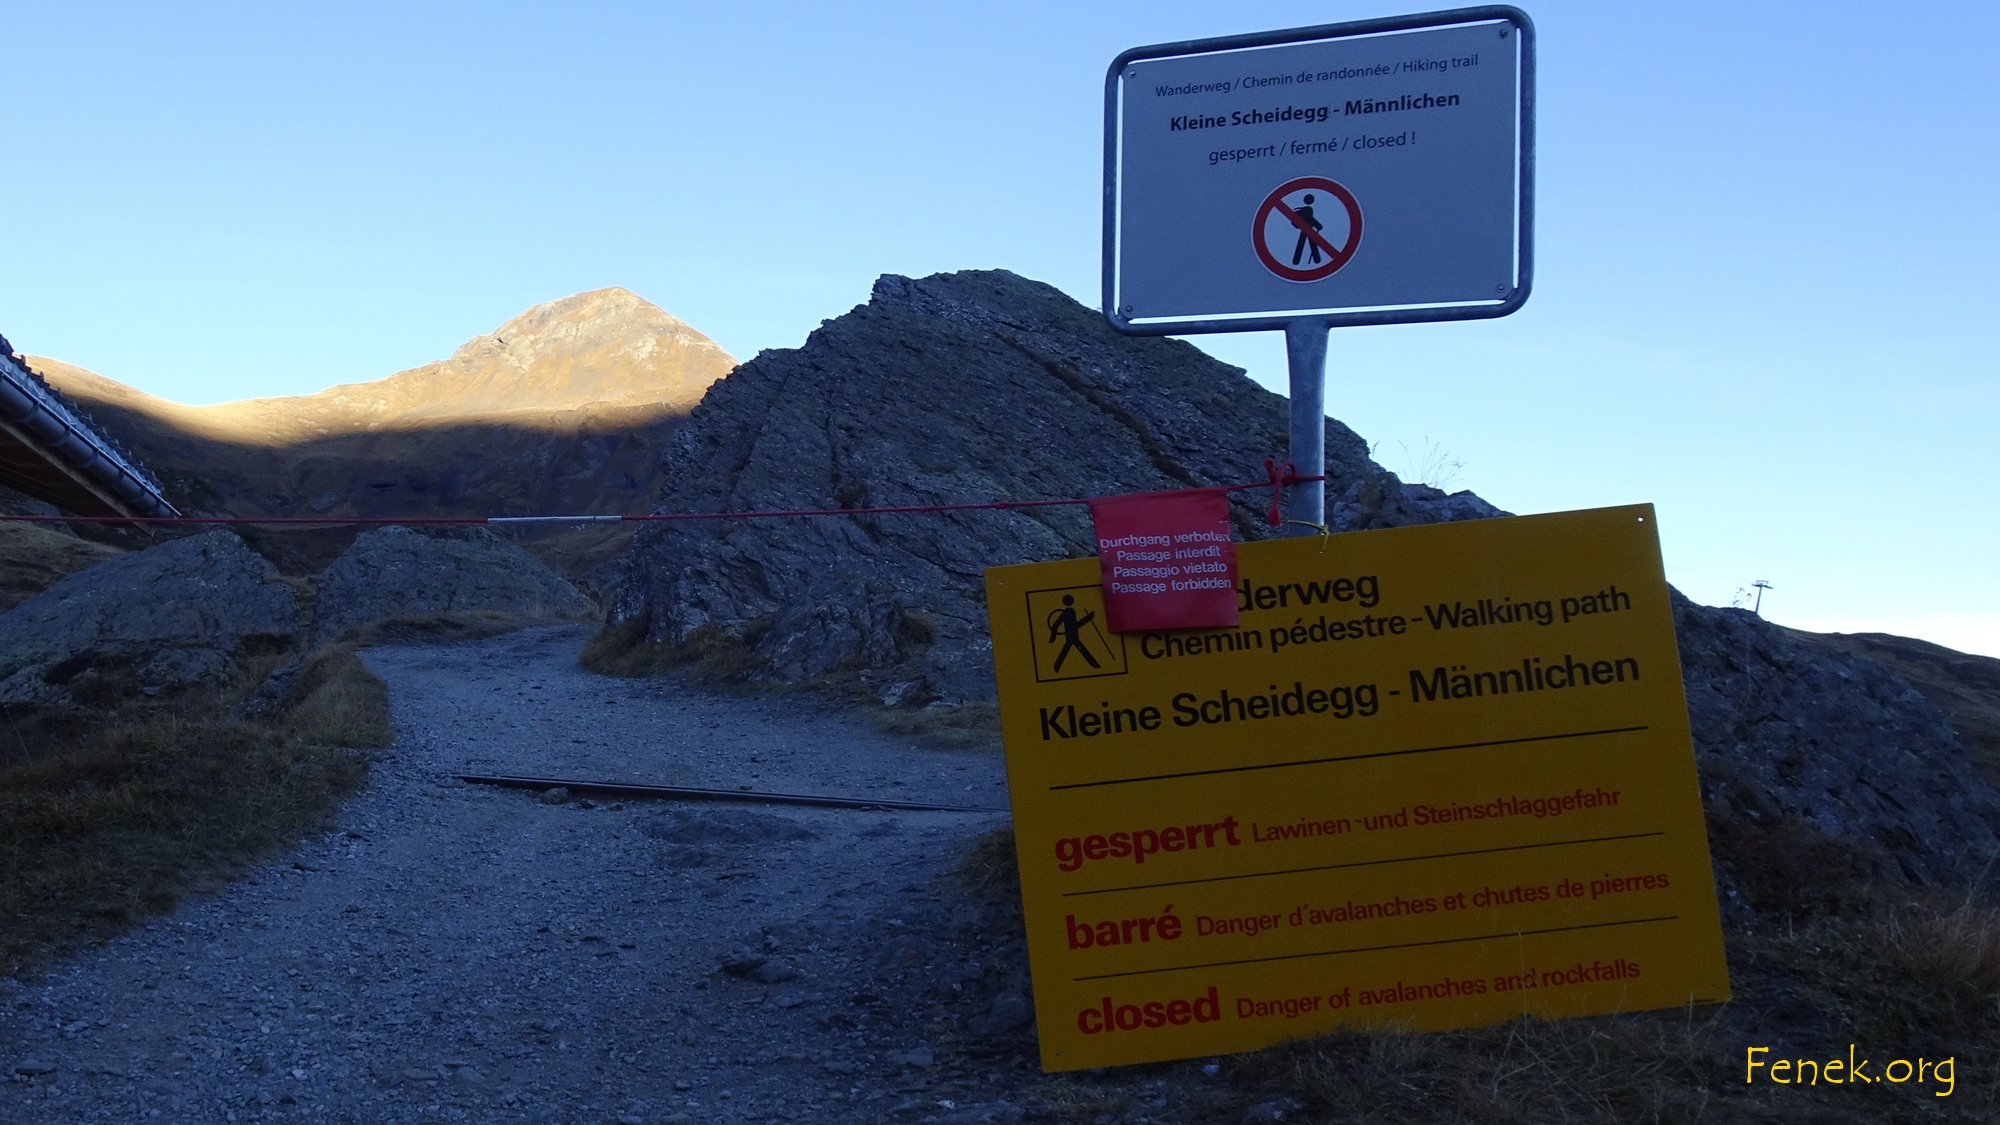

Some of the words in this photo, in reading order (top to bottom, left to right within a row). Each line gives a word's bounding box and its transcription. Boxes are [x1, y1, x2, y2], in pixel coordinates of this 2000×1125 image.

[1155, 81, 1231, 97] Wanderweg
[1234, 78, 1241, 89] /
[1242, 74, 1293, 89] Chemin
[1296, 71, 1313, 83] de
[1316, 64, 1390, 81] randonnée
[1393, 62, 1399, 74] /
[1403, 59, 1448, 72] Hiking
[1451, 54, 1478, 68] trail
[1170, 114, 1226, 131] Kleine
[1231, 105, 1328, 126] Scheidegg
[1345, 93, 1460, 116] Männlichen
[1209, 144, 1275, 165] gesperrt
[1279, 142, 1286, 156] /
[1290, 137, 1338, 155] fermé
[1342, 137, 1349, 151] /
[1353, 132, 1407, 150] closed
[1411, 131, 1416, 145] !
[1100, 534, 1170, 548] Durchgang
[1174, 531, 1230, 544] verboten
[1116, 550, 1171, 562] Passage
[1175, 546, 1221, 559] interdit
[1112, 582, 1166, 594] Passage
[1171, 577, 1231, 591] forbidden
[1113, 564, 1179, 578] Passaggio
[1183, 561, 1227, 574] vietato
[1237, 574, 1380, 612] derweg
[1141, 627, 1262, 660] Chemin
[1561, 585, 1631, 623] path
[1039, 702, 1162, 741] Kleine
[1172, 682, 1380, 728] Scheidegg
[1409, 655, 1640, 703] Männlichen
[1055, 815, 1242, 873] gesperrt
[1252, 817, 1352, 843] Lawinen
[1413, 787, 1621, 826] Steinschlaggefahr
[1065, 904, 1183, 950] barré
[1196, 912, 1282, 937] Danger
[1443, 891, 1467, 910] et
[1472, 884, 1550, 908] chutes
[1555, 878, 1585, 899] de
[1590, 872, 1670, 900] pierres
[1077, 986, 1221, 1035] closed
[1236, 993, 1322, 1019] Danger
[1328, 987, 1351, 1010] of
[1358, 971, 1488, 1007] avalanches
[1493, 967, 1537, 991] and
[1541, 958, 1641, 988] rockfalls
